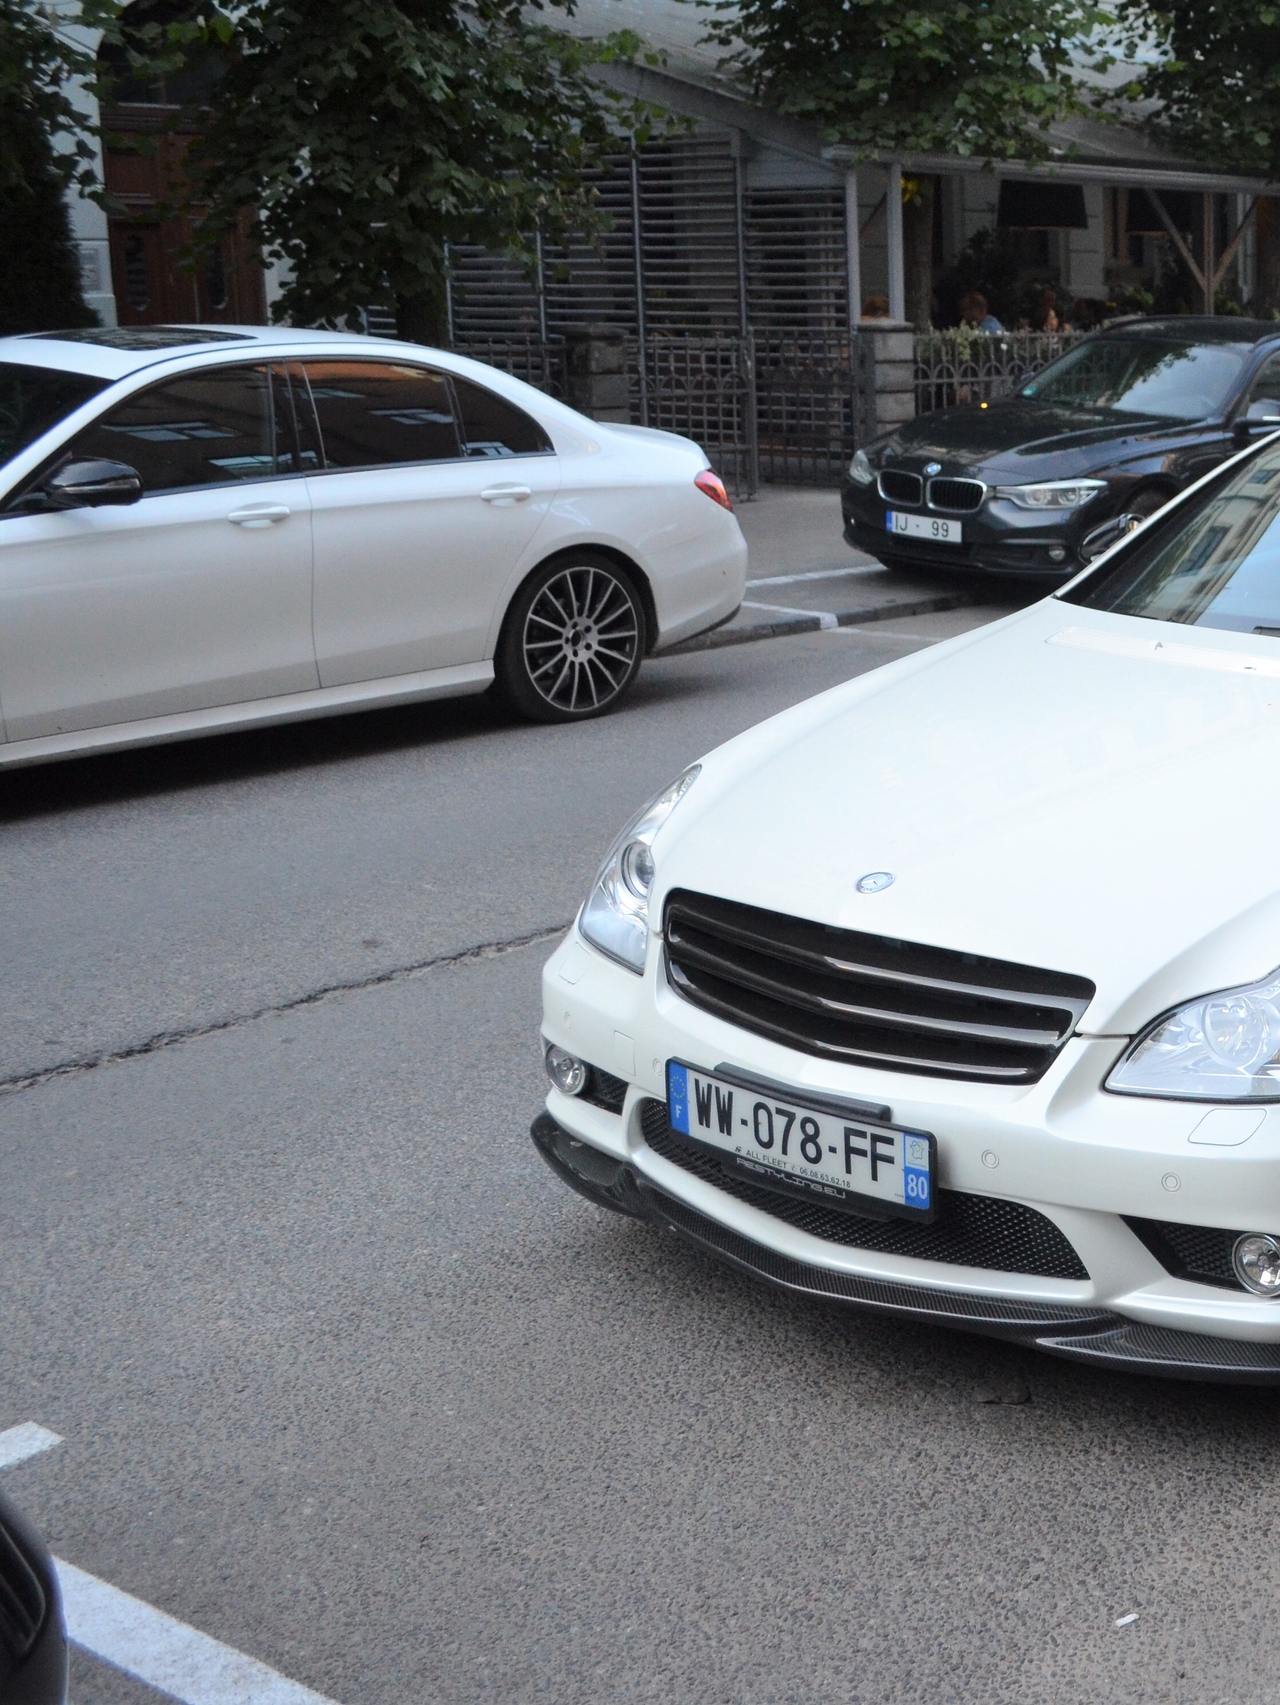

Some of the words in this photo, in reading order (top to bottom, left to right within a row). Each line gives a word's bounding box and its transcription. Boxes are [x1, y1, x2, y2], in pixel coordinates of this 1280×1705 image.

[675, 1104, 682, 1118] F
[694, 1078, 895, 1182] WW-078-FF
[746, 1149, 762, 1161] ALL
[763, 1155, 787, 1170] FLEET
[799, 1167, 851, 1188] 06.08.63.62.18
[907, 1173, 928, 1200] 80
